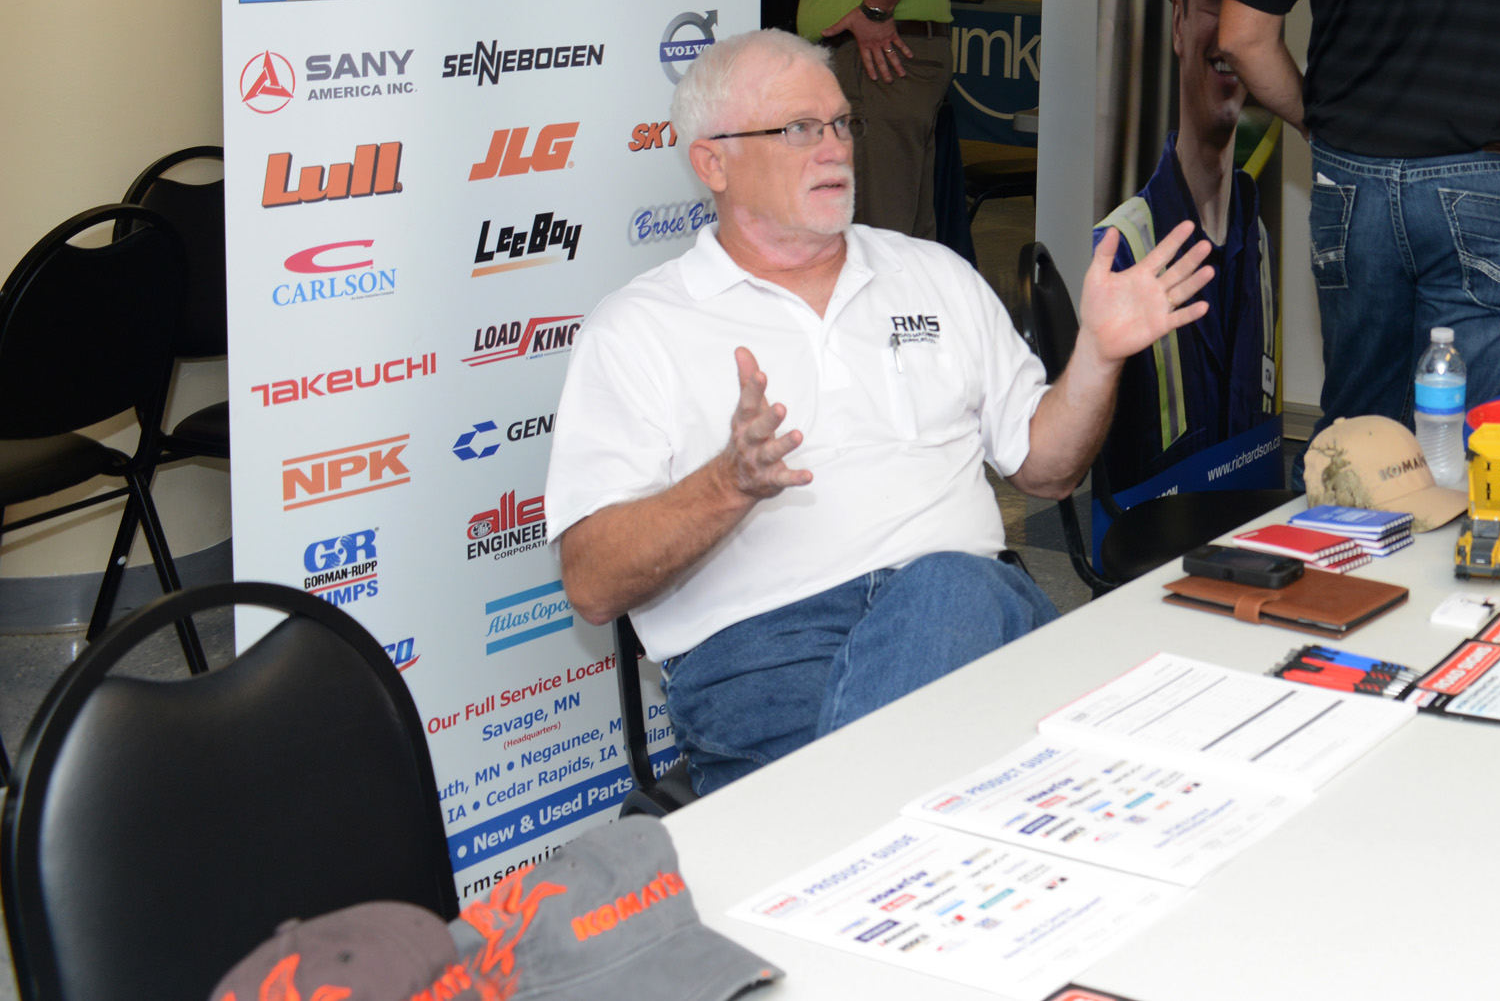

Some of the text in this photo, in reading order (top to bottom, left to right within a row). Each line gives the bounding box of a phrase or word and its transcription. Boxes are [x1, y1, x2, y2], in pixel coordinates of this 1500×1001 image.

[305, 49, 415, 81] SANY
[442, 40, 605, 86] SENNEBOGEN
[307, 81, 418, 101] AMERICA INC.
[468, 121, 580, 181] JLG
[262, 141, 403, 209] Lull
[474, 212, 582, 263] LeeBoy
[634, 210, 684, 239] Broce
[272, 268, 396, 306] CARLSON
[474, 321, 522, 352] LOAD
[890, 315, 940, 332] RMS
[251, 352, 436, 407] TAKEUCHI
[507, 413, 554, 441] GEN
[282, 443, 411, 502] NPK
[1207, 435, 1282, 482] www.richardson.ca
[304, 560, 378, 590] GORMAN-RUPP
[316, 579, 379, 608] UMPS
[486, 610, 530, 637] Atlas
[427, 653, 616, 735] Our Full Service Locati
[482, 692, 580, 742] Savage, MN
[503, 721, 562, 751] (Headquarters)
[437, 779, 470, 801] uth,
[475, 764, 501, 786] MN
[521, 727, 605, 769] Negaunee,
[609, 718, 622, 734] M
[447, 808, 467, 824] IA
[486, 778, 533, 807] Cedar
[538, 757, 596, 787] Rapids,
[599, 744, 618, 763] IA
[473, 824, 515, 854] New
[519, 814, 535, 834] &
[539, 791, 583, 826] Used
[587, 776, 633, 812] Parts
